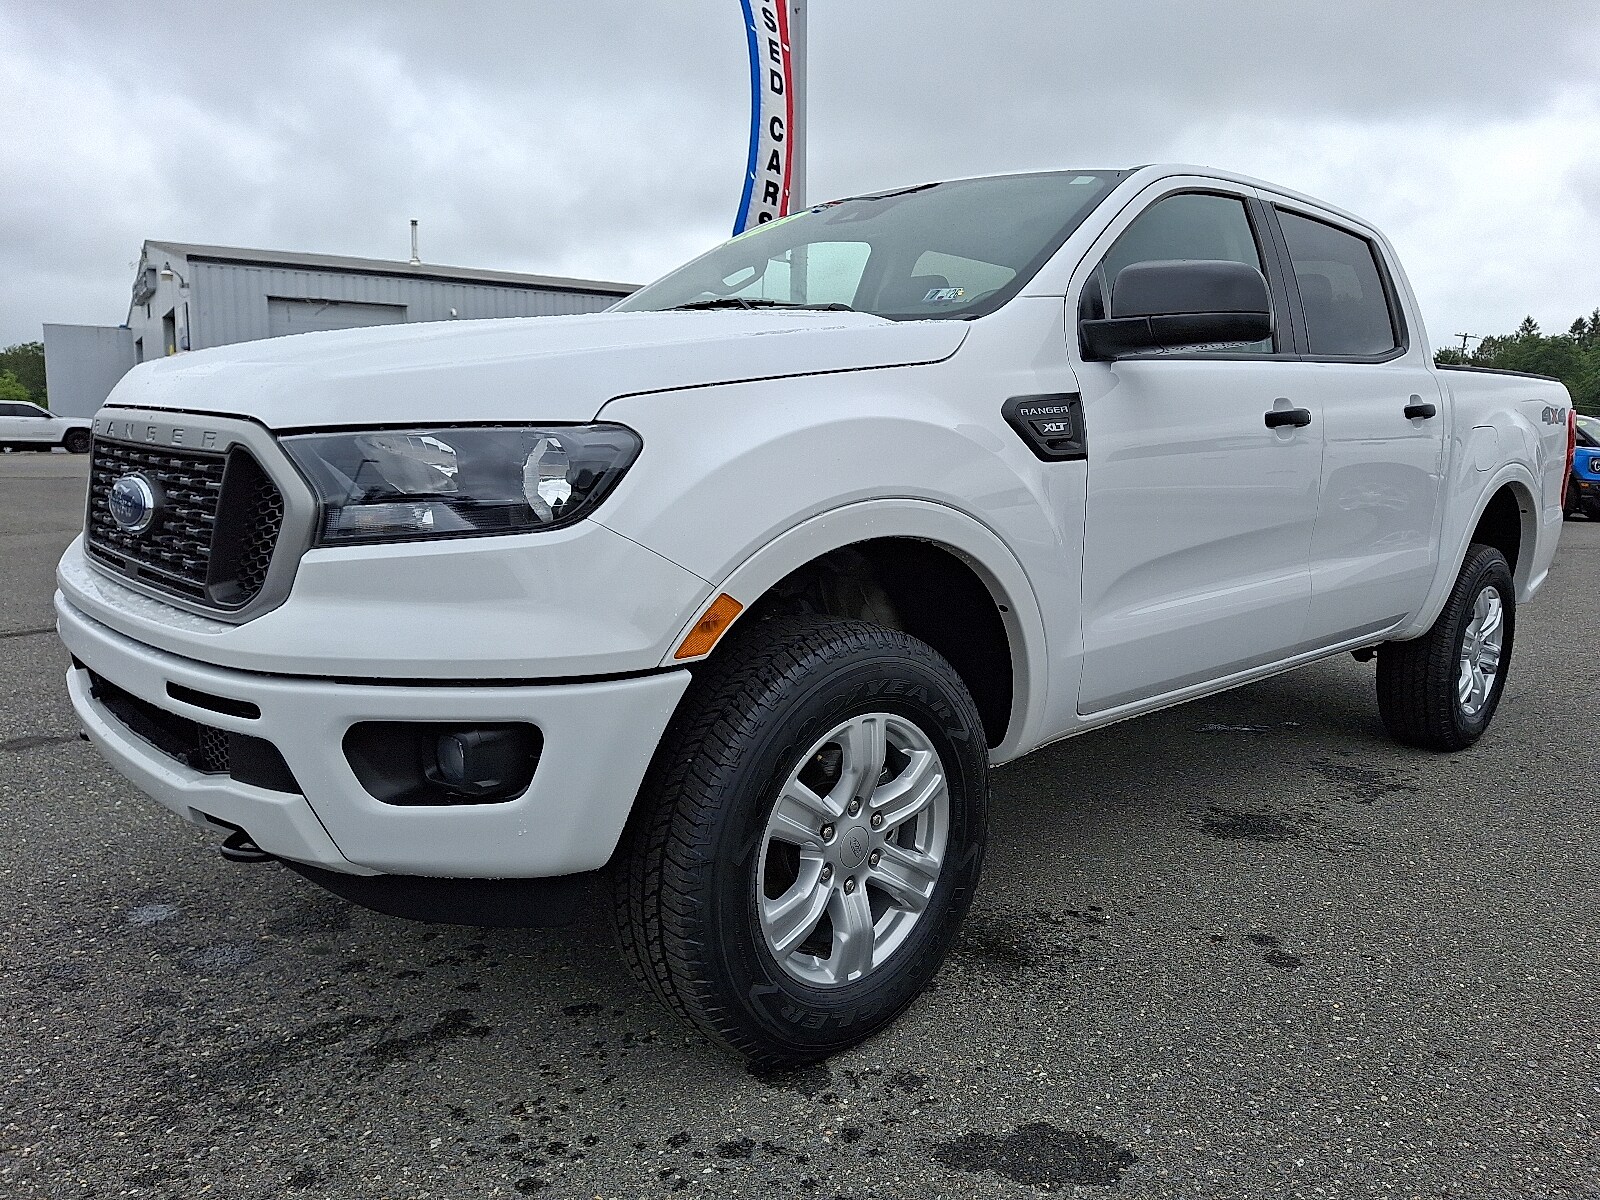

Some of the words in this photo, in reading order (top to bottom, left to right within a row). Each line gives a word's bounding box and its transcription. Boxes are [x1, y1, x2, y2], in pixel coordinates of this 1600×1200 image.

[762, 0, 784, 95] SED
[1020, 406, 1069, 416] RANGER
[93, 419, 217, 448] RANGER
[1042, 422, 1067, 432] XLT
